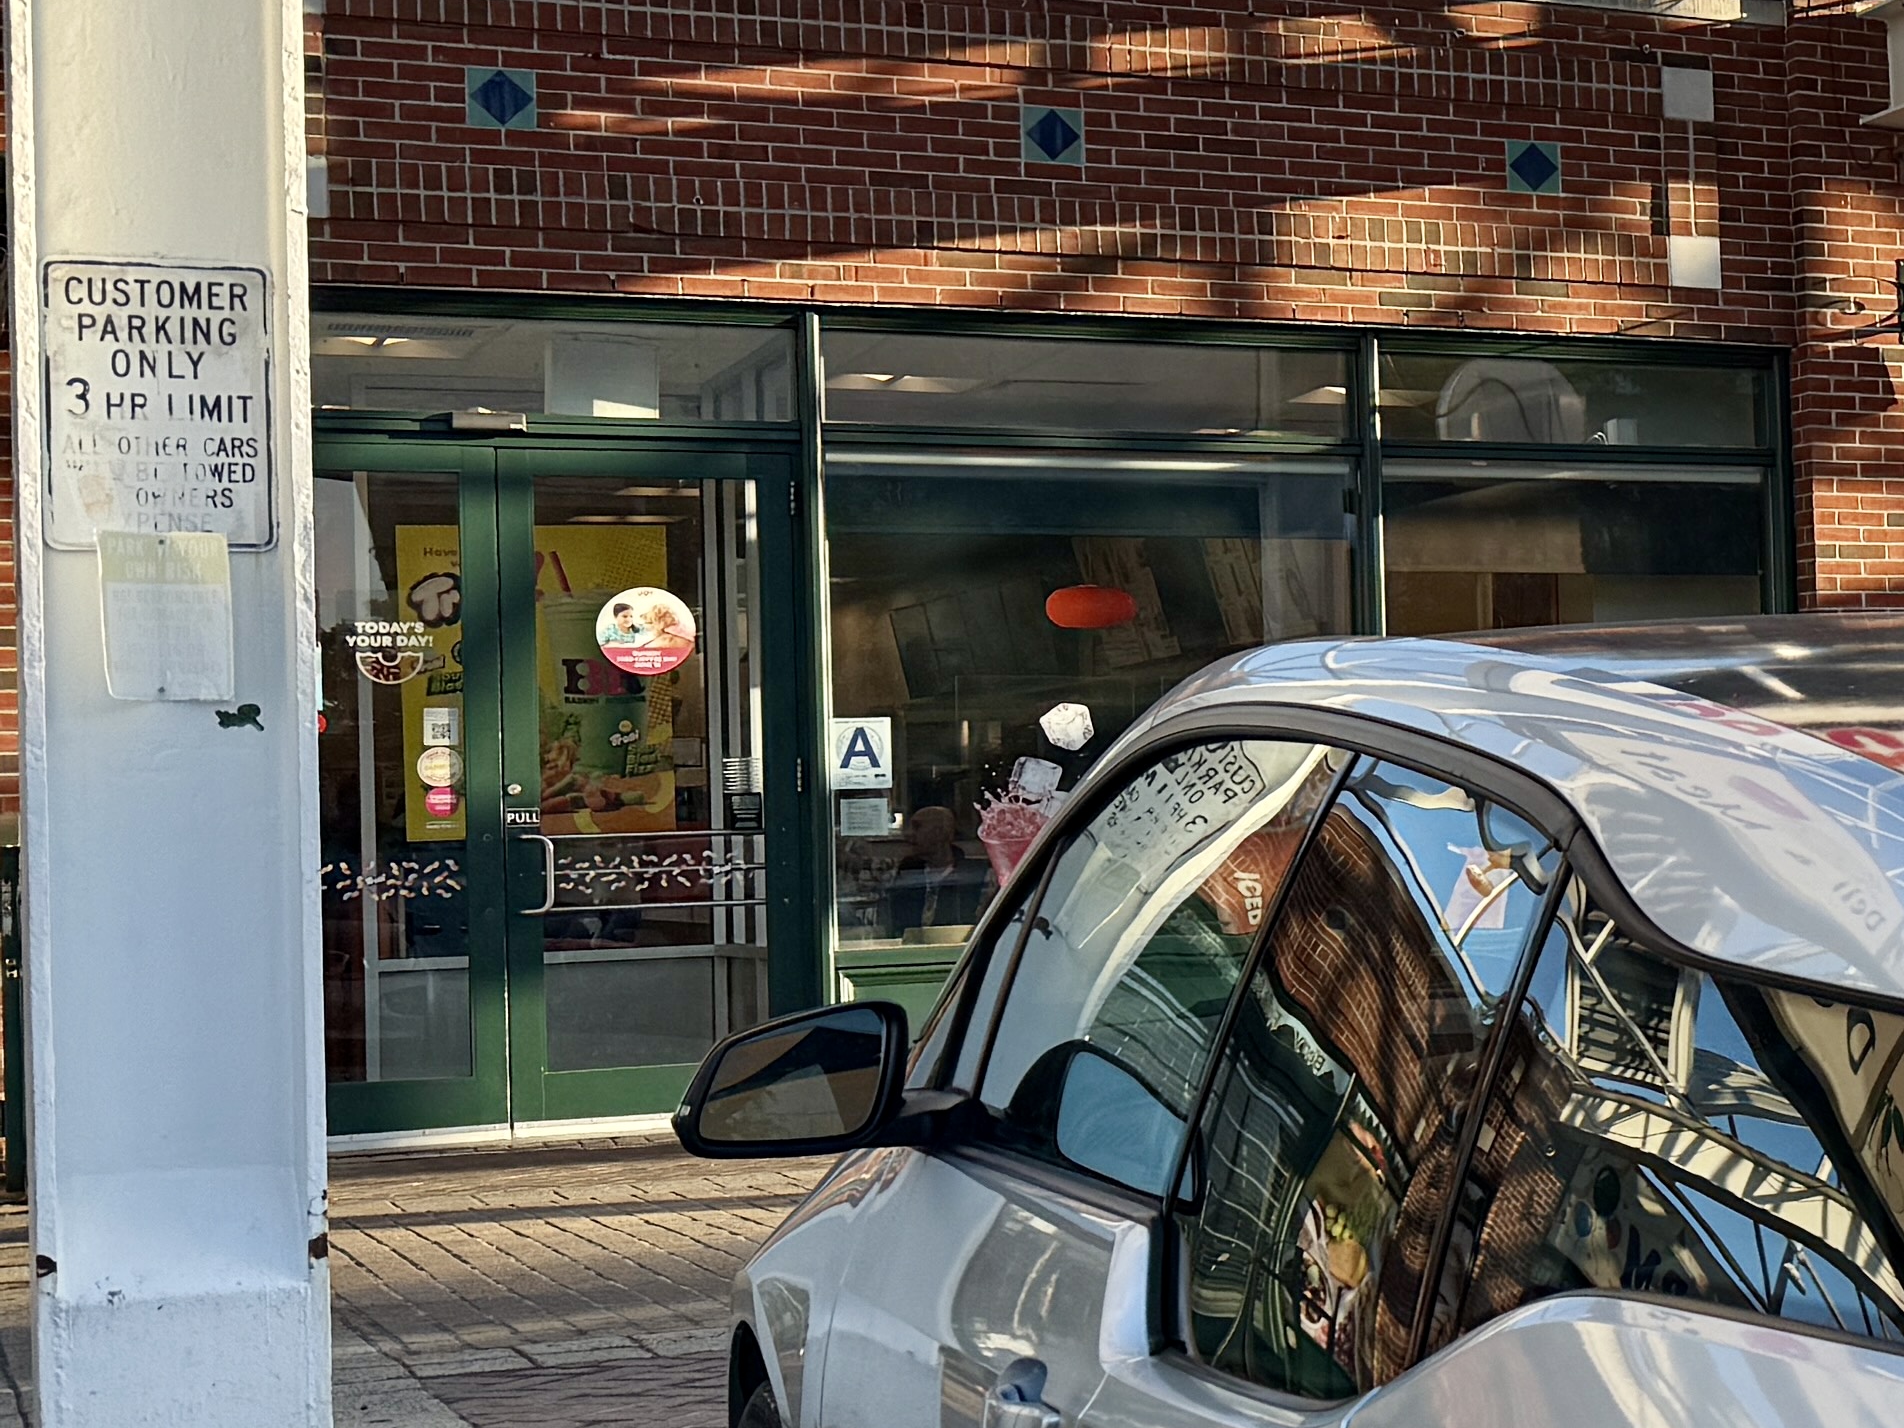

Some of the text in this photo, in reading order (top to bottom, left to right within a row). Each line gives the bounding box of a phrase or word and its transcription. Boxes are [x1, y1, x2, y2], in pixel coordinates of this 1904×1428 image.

[63, 276, 249, 313] CUSTOMER
[76, 315, 238, 346] PARKING
[111, 349, 206, 380] ONLY
[65, 377, 254, 424] 3 HR LIMIT
[203, 437, 259, 459] CARS
[345, 634, 434, 648] YOUR DAY!
[354, 621, 425, 634] TODAY'S
[839, 726, 882, 769] A
[506, 812, 540, 823] PULL
[1232, 870, 1265, 926] ICED
